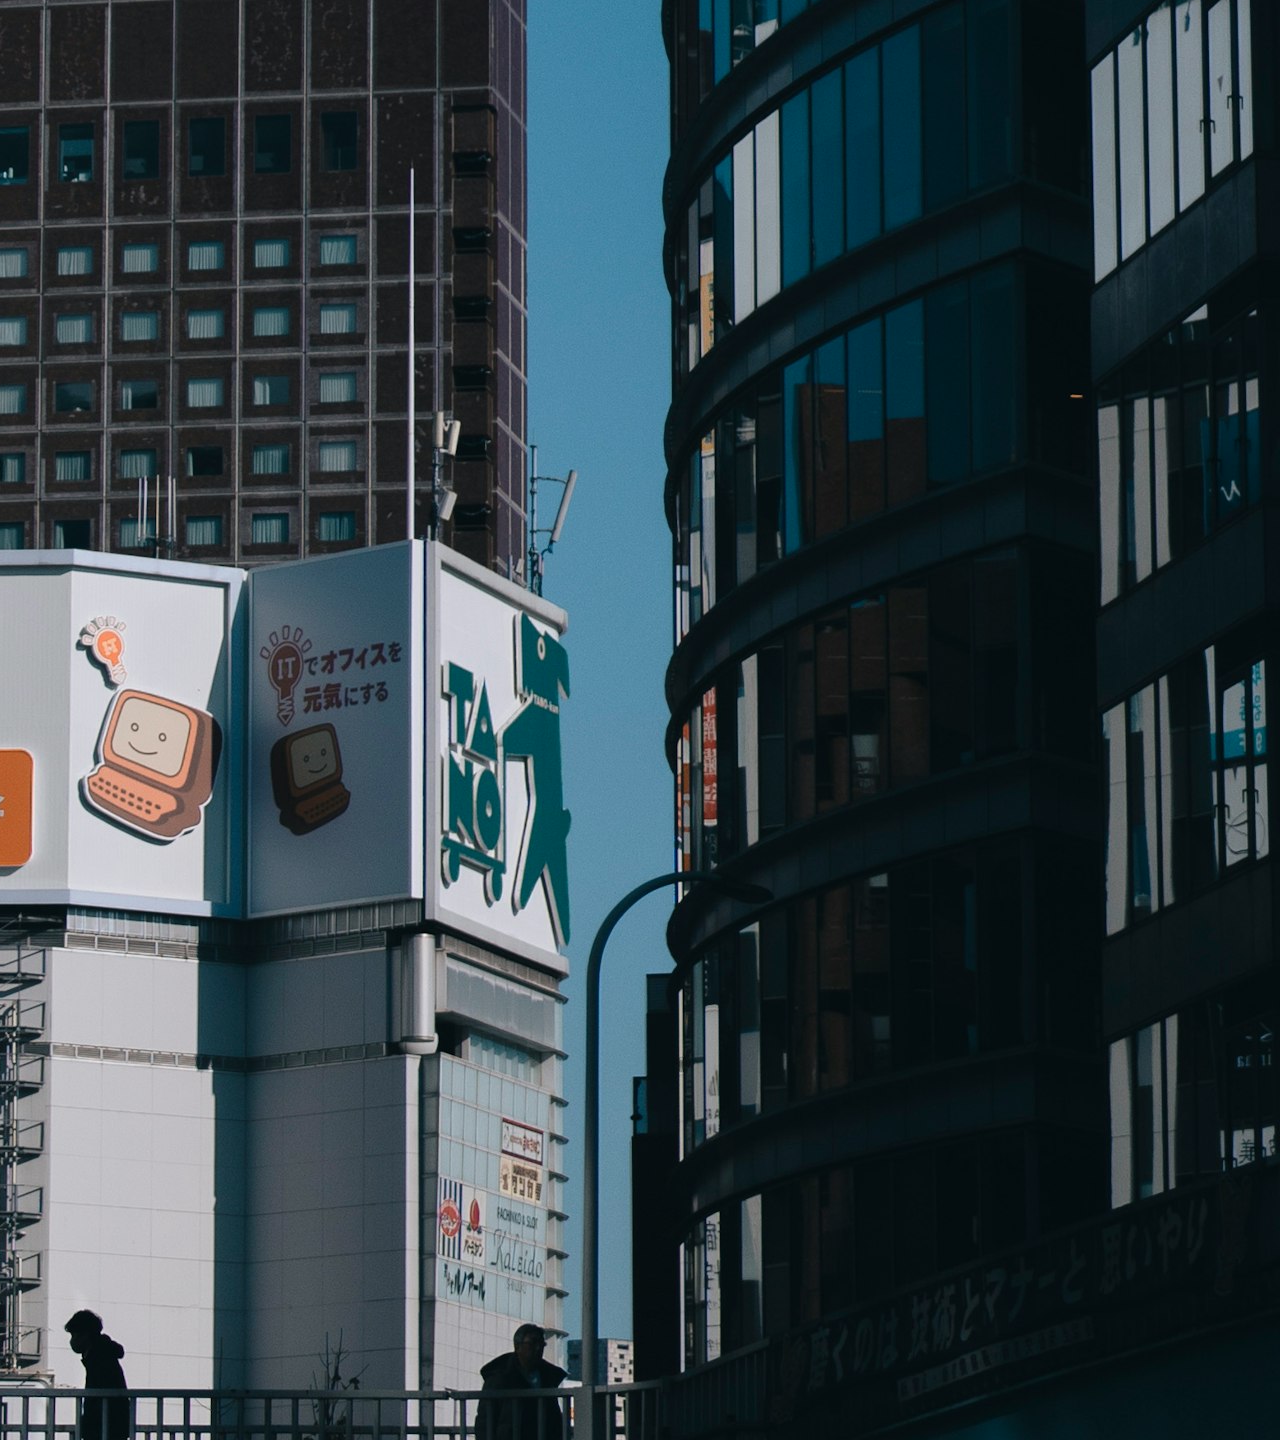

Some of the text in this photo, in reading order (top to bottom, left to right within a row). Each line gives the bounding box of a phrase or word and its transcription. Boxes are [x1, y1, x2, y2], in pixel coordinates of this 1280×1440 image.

[276, 656, 296, 680] IT
[303, 681, 388, 714] 元気にする
[490, 1228, 543, 1279] Kaleido
